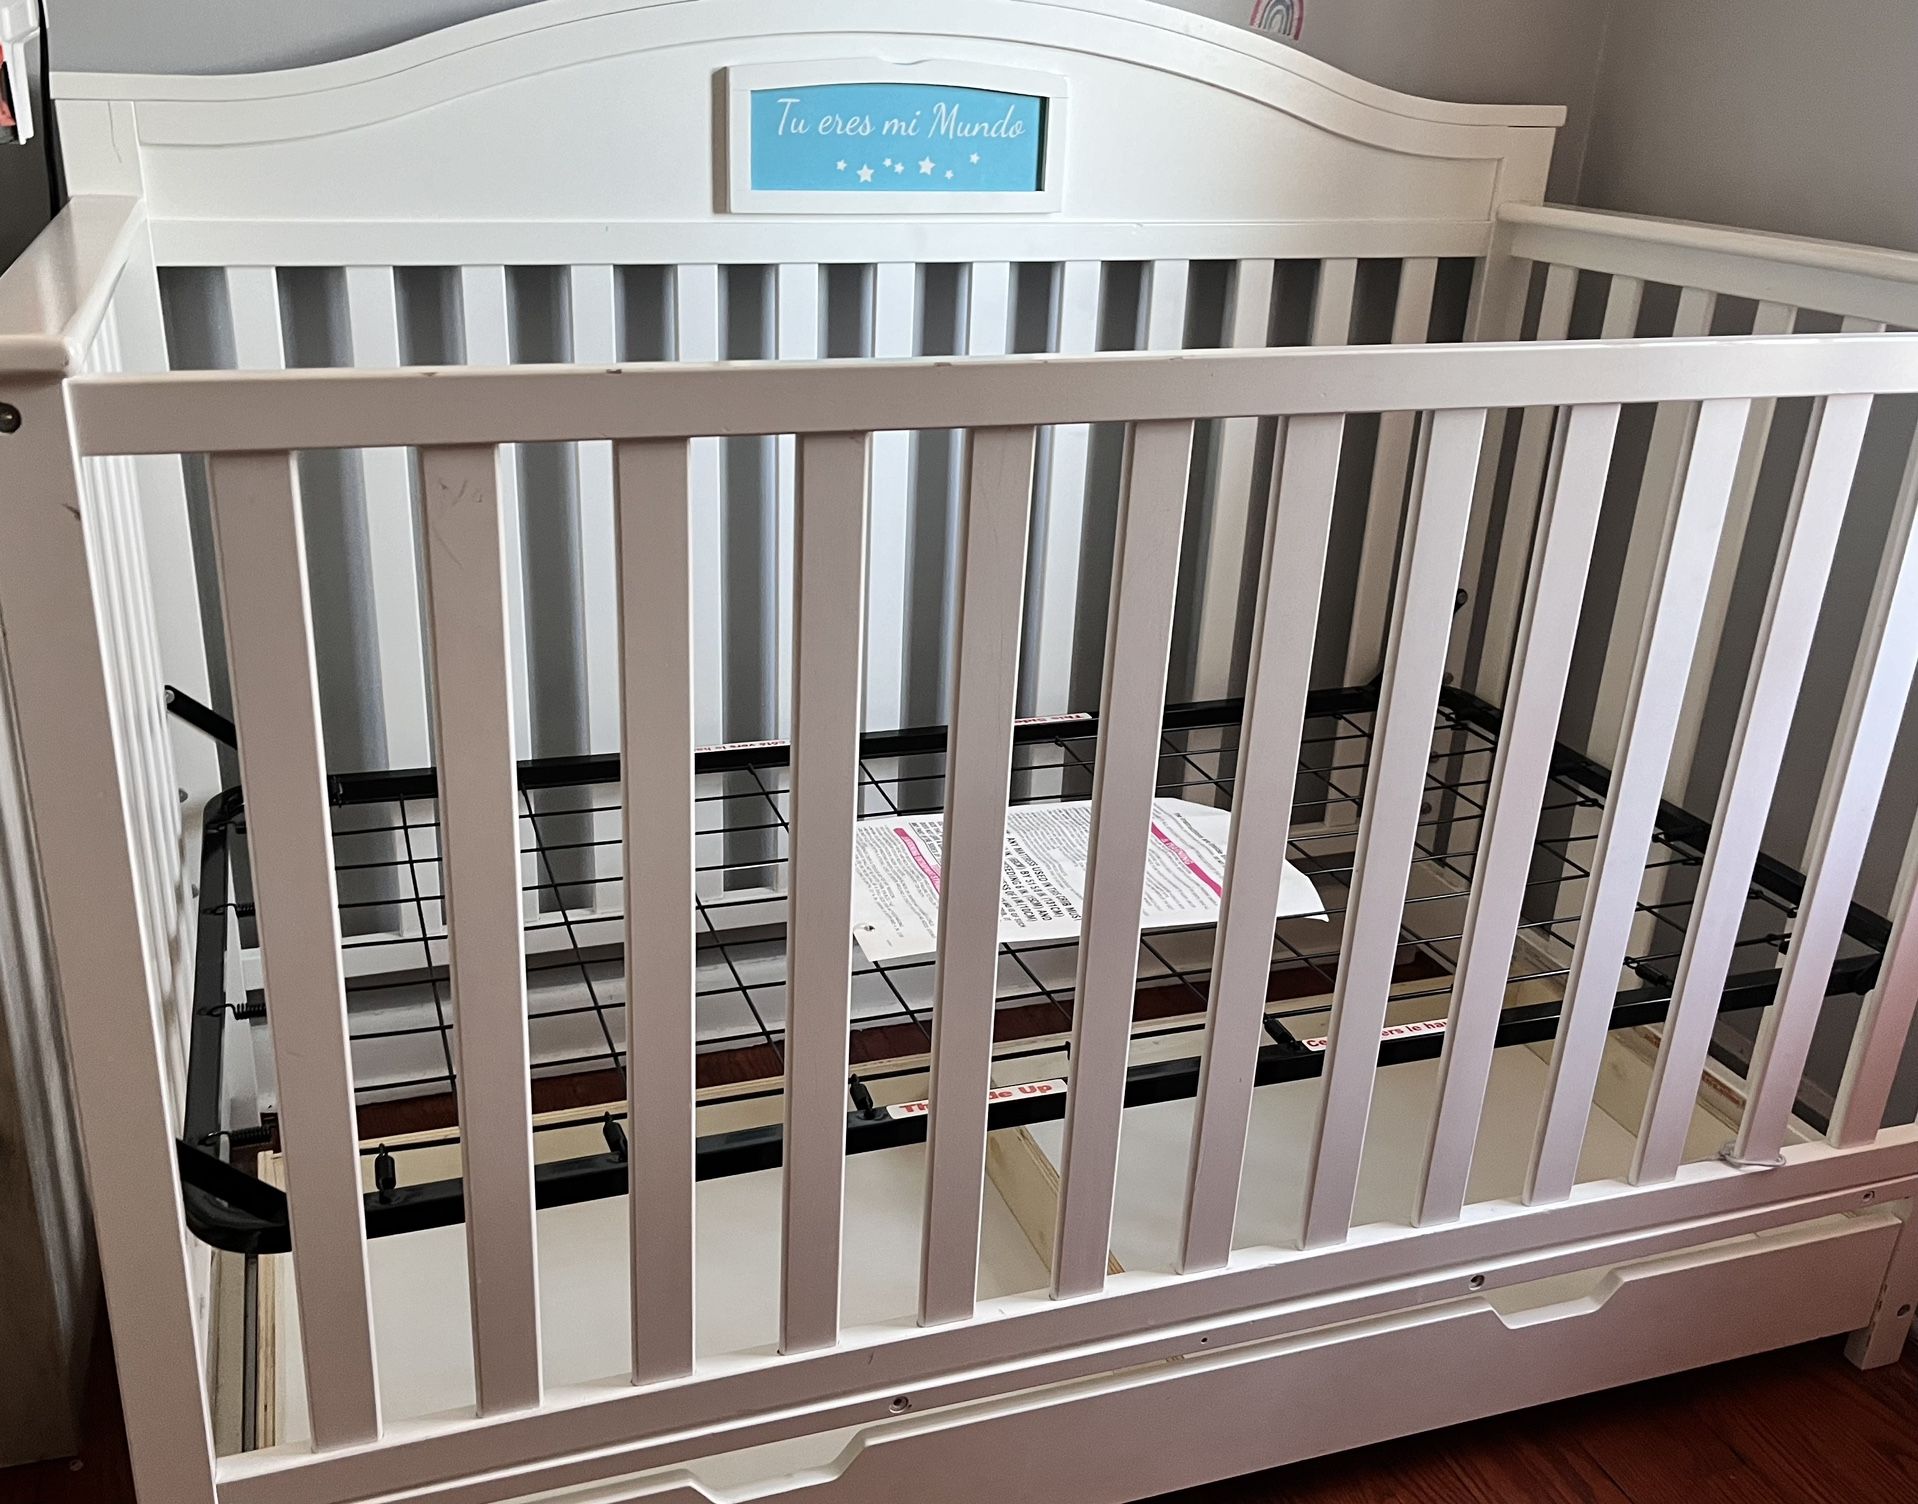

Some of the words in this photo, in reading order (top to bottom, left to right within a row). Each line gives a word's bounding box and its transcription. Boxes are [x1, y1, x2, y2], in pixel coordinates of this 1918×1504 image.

[776, 98, 808, 136] Tu
[818, 114, 875, 136] eres
[882, 110, 921, 136] mi
[928, 101, 1027, 139] Mundo
[1020, 870, 1032, 878] BY
[1032, 866, 1049, 882] USED
[1037, 910, 1053, 921] AND
[1382, 1028, 1405, 1036] ers
[900, 1103, 929, 1113] Th
[989, 1089, 1013, 1100] de
[1018, 1083, 1053, 1094] Up
